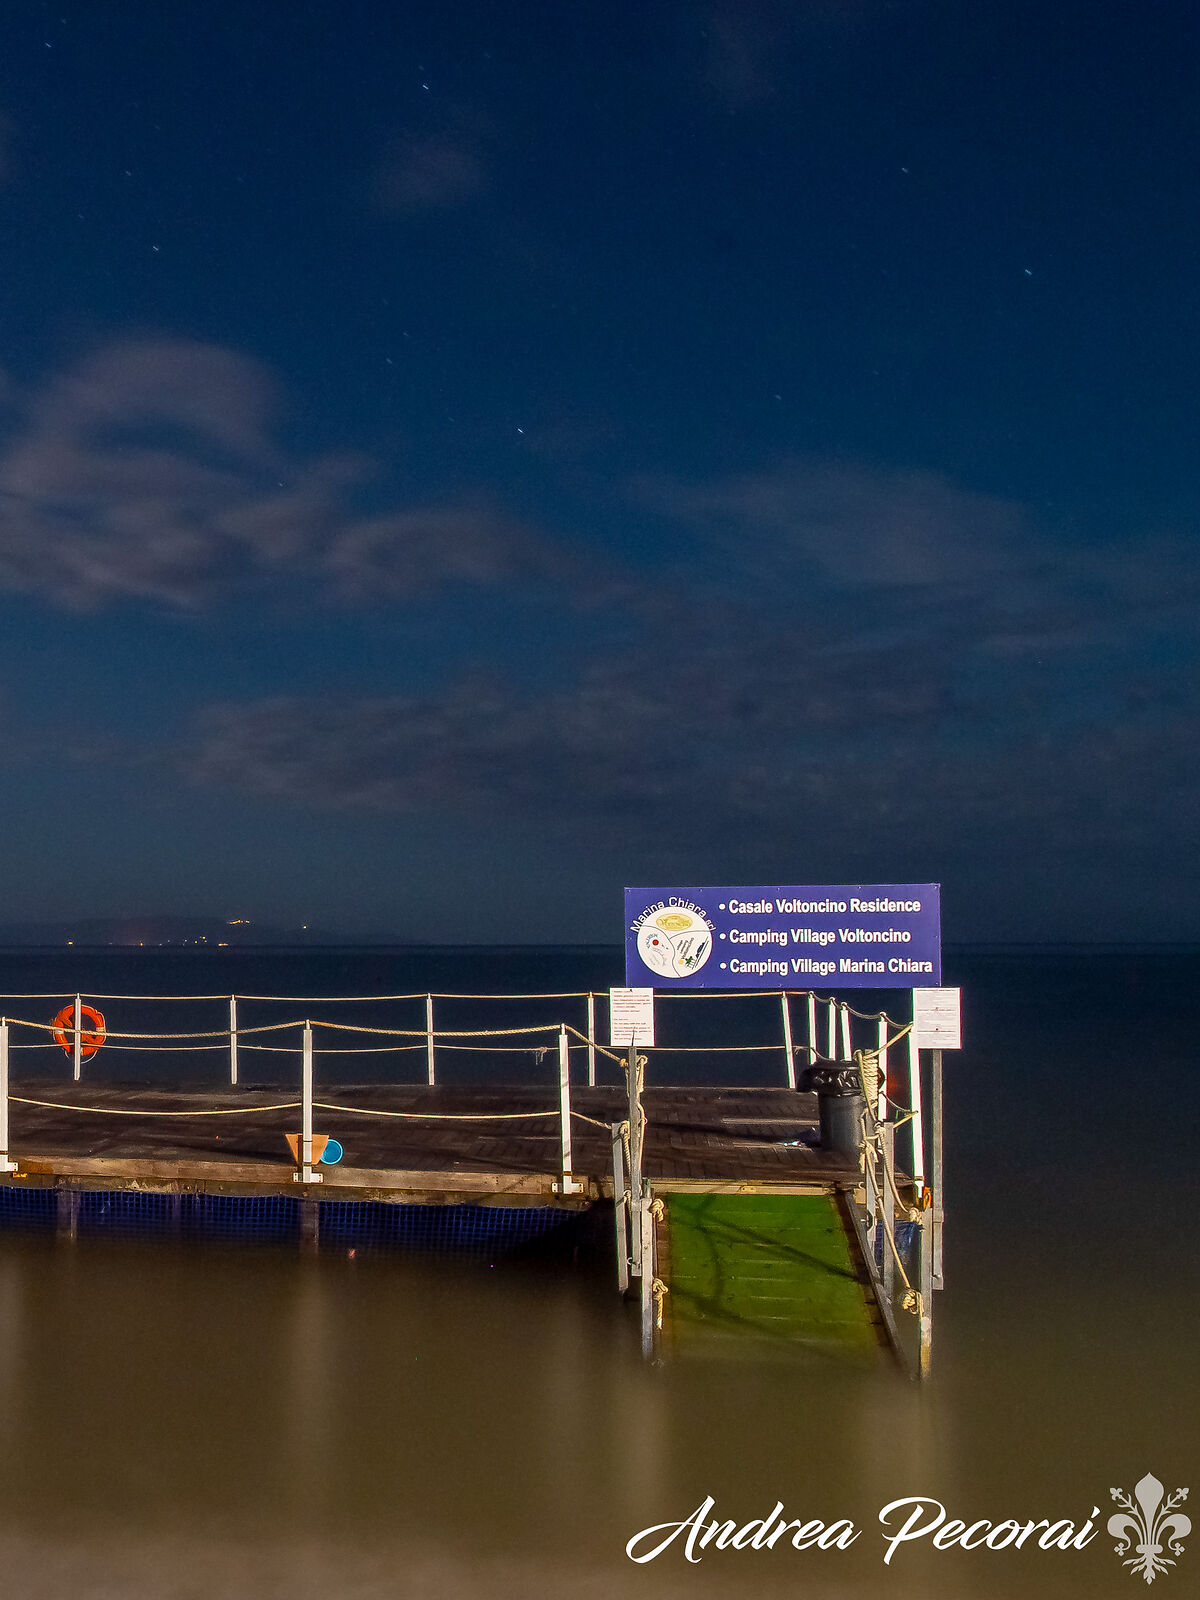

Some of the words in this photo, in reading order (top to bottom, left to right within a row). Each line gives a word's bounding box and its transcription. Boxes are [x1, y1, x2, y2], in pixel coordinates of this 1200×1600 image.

[630, 901, 665, 933] Marina
[668, 896, 707, 918] Chiara
[728, 899, 773, 914] Casale
[775, 898, 847, 914] Voltoncino
[850, 897, 921, 913] Residence
[729, 928, 788, 947] Camping
[790, 928, 836, 947] Village
[838, 928, 911, 943] Voltoncino
[729, 958, 788, 977] Camping
[790, 958, 836, 977] Village
[839, 958, 885, 973] Marina
[888, 957, 933, 973] Chiara
